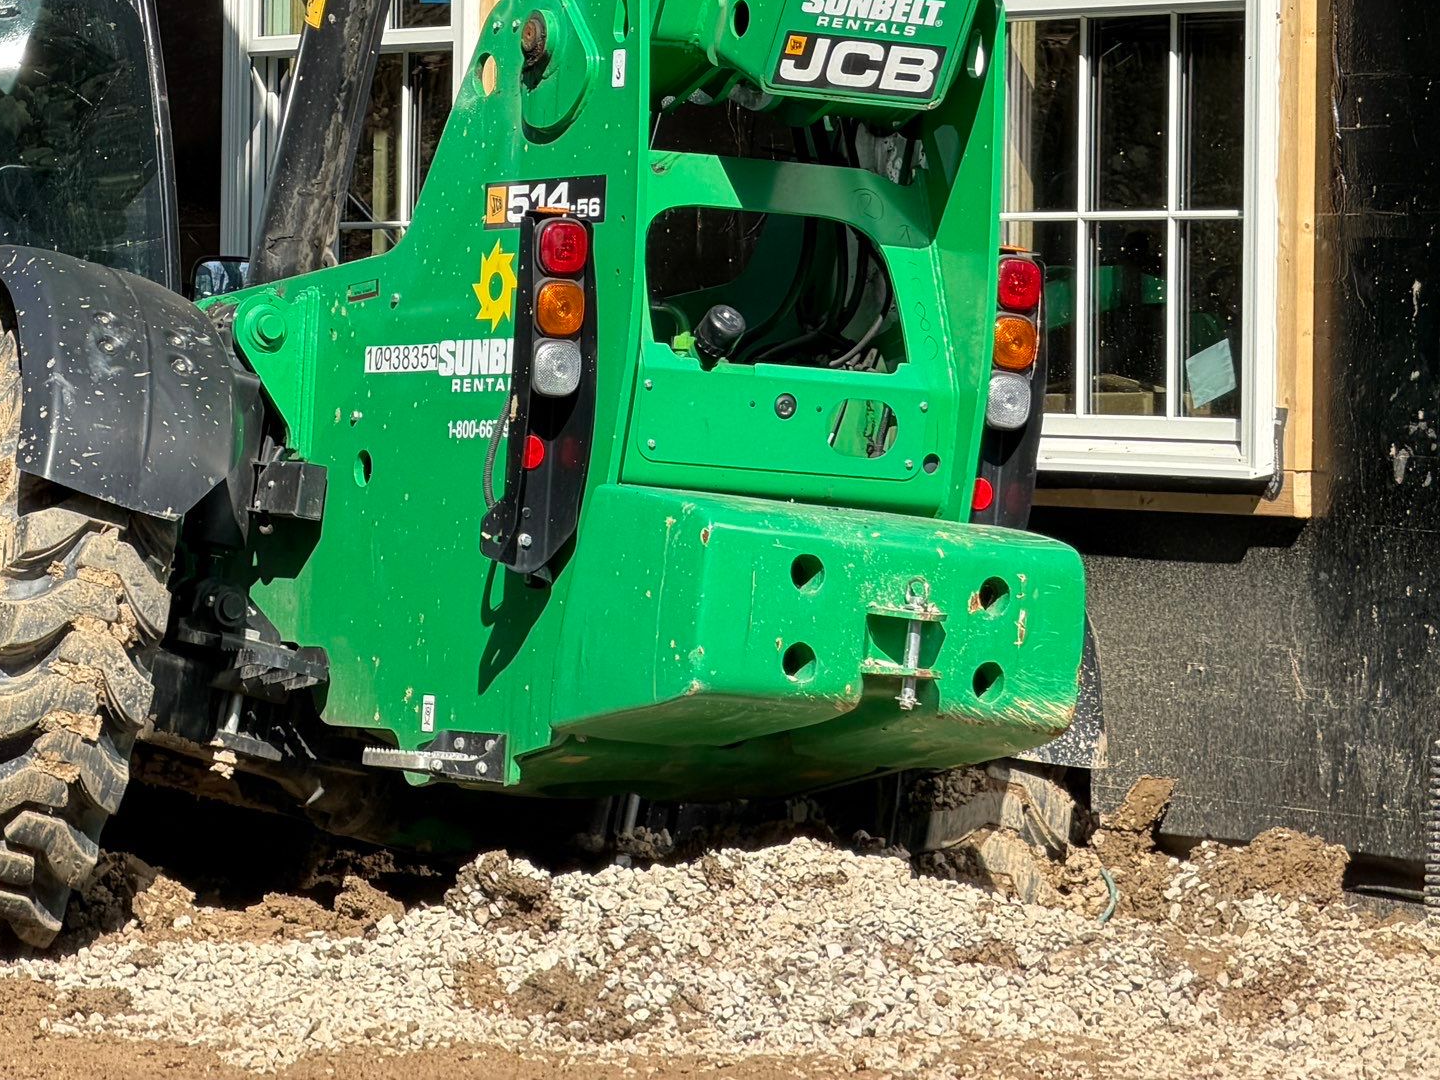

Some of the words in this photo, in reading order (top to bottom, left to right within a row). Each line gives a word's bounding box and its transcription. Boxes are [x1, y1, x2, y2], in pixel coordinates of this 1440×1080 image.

[816, 15, 917, 37] RENTALS
[779, 37, 939, 93] JCB
[366, 344, 439, 371] 10938359
[438, 338, 514, 376] SUNB
